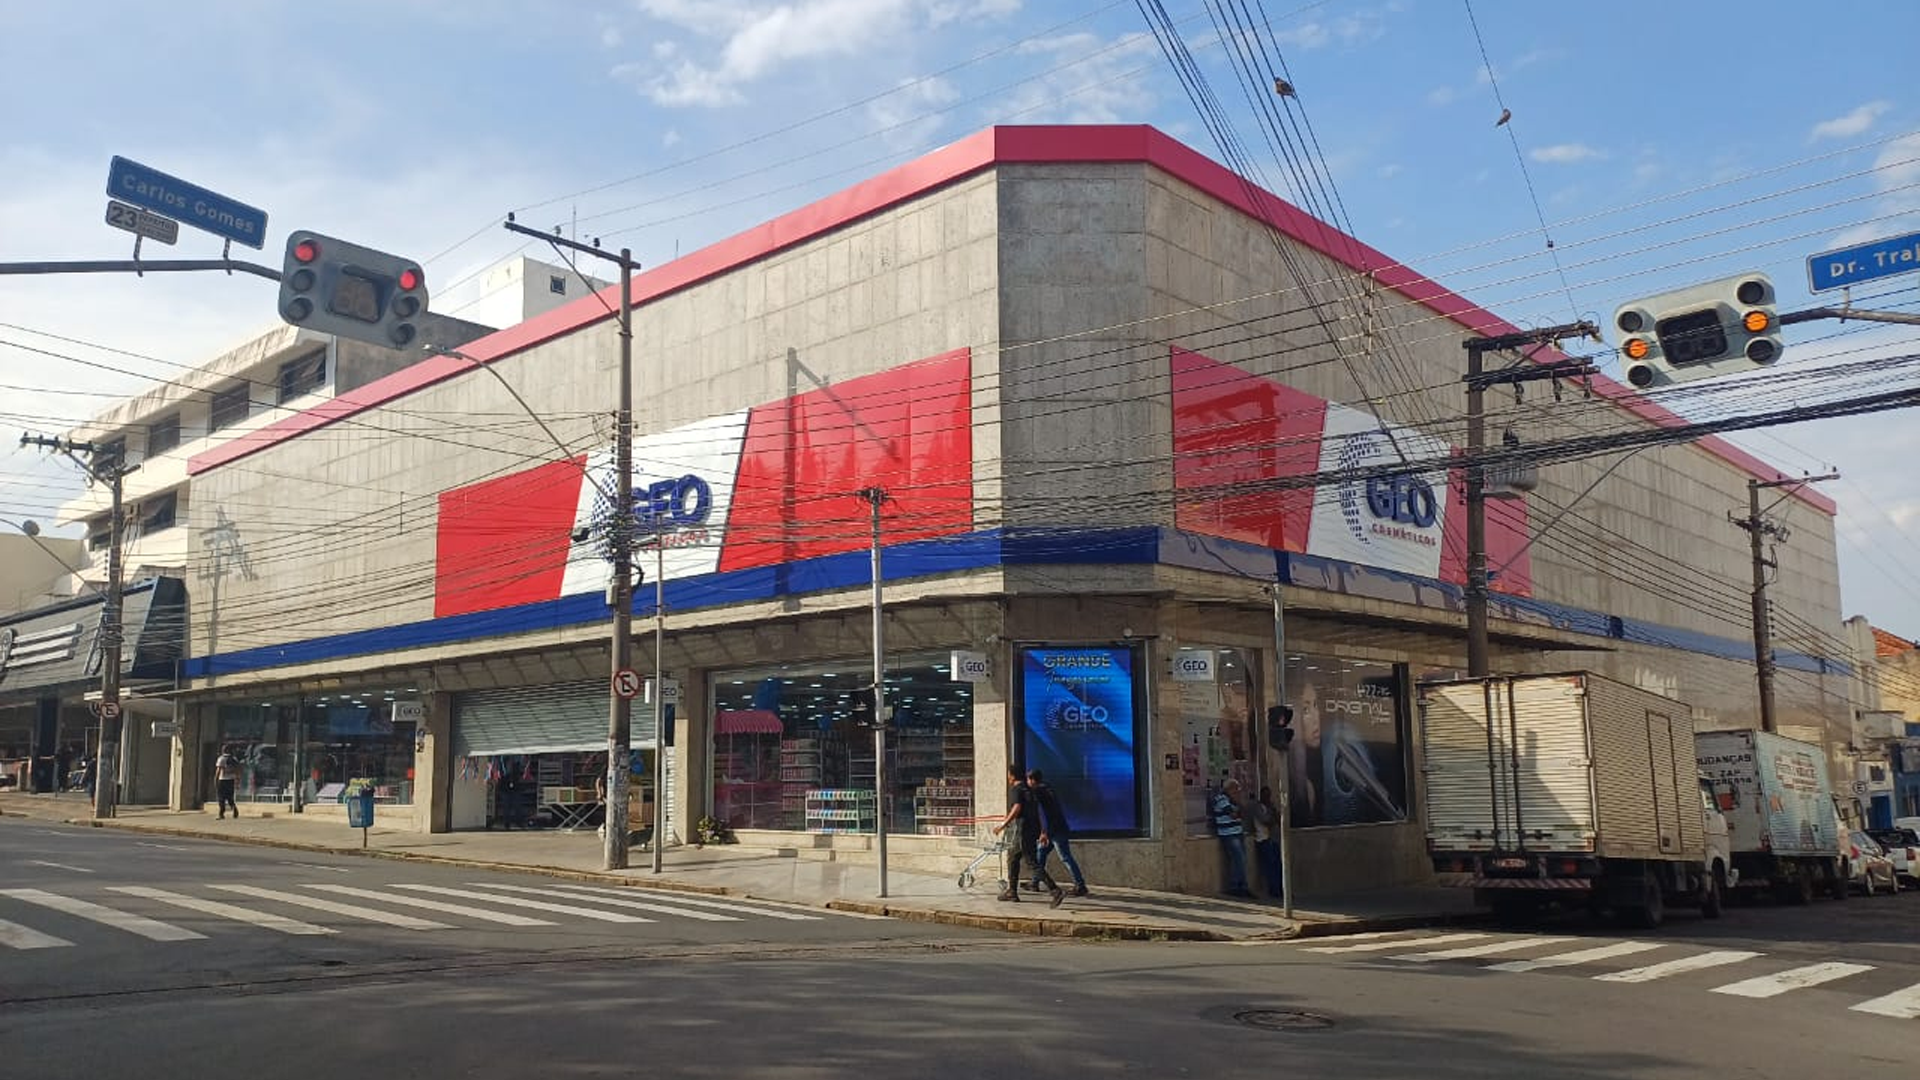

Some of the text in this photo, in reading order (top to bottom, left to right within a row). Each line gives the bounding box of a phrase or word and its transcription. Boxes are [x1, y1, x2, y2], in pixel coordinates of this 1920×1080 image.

[122, 174, 186, 209] Carlos
[194, 200, 255, 234] Gomes
[110, 206, 137, 228] 23
[1829, 261, 1866, 278] Dr.
[1366, 472, 1437, 528] GEO
[965, 661, 985, 672] GEO
[1043, 653, 1112, 668] GRANDE
[1182, 660, 1208, 672] GEO
[1063, 705, 1109, 723] GEO
